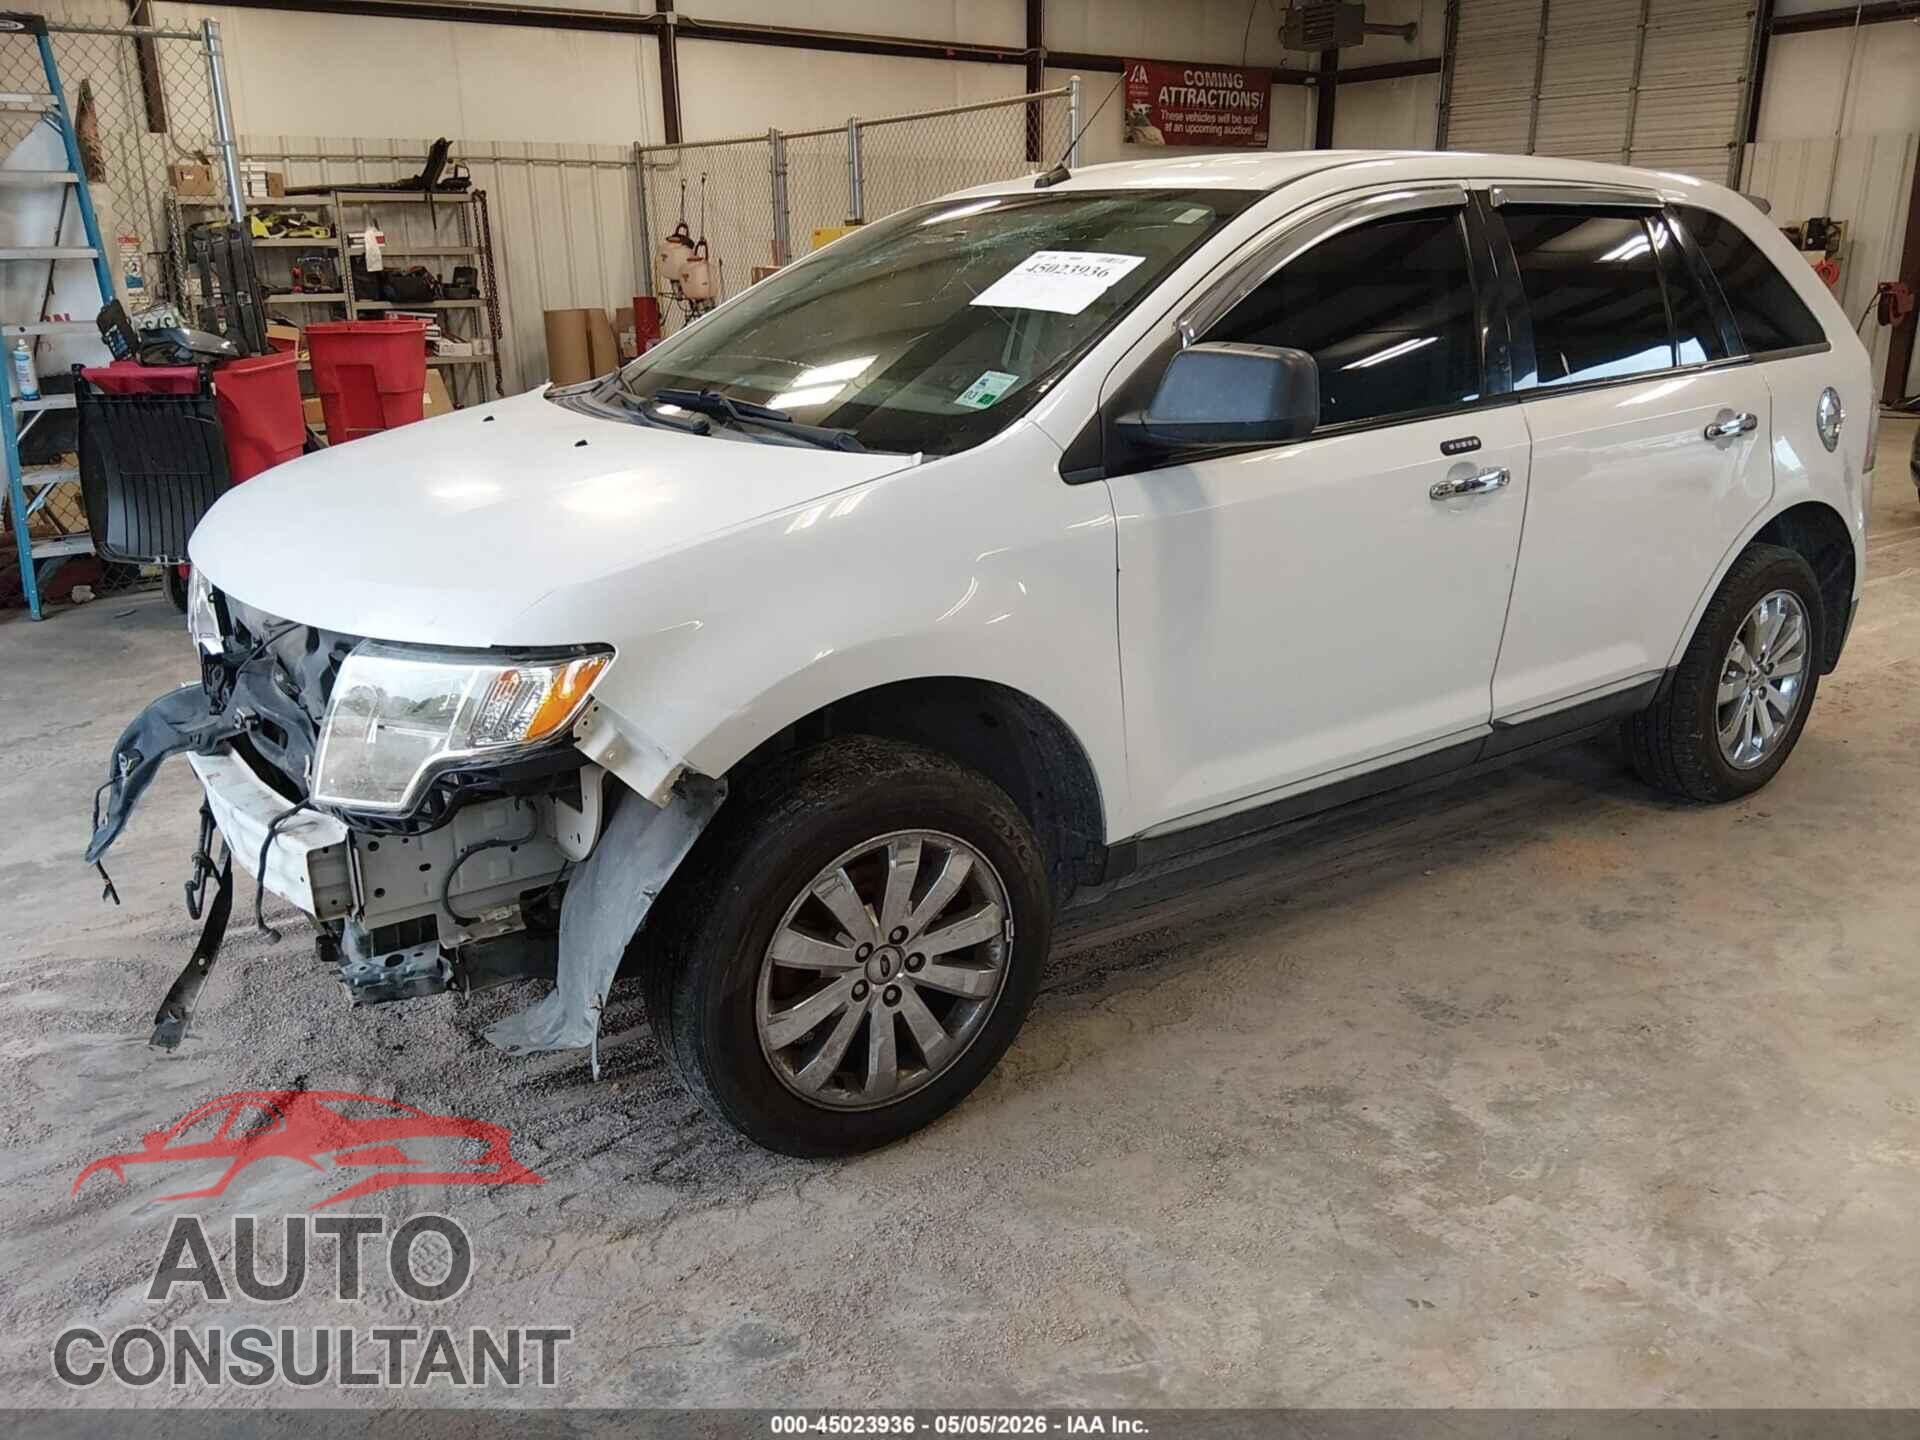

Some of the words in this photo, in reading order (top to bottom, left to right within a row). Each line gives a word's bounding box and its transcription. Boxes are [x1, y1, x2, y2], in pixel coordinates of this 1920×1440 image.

[1183, 70, 1244, 89] COMING
[1158, 86, 1265, 112] ATTRACTIONS!
[1160, 109, 1184, 121] These
[1185, 112, 1216, 123] vehicles
[1217, 113, 1230, 123] will
[1231, 113, 1242, 124] be
[1244, 114, 1258, 125] sold
[1165, 123, 1173, 132] at
[1173, 124, 1184, 133] an
[1185, 124, 1223, 136] upcoming
[1025, 262, 1110, 278] 45023936
